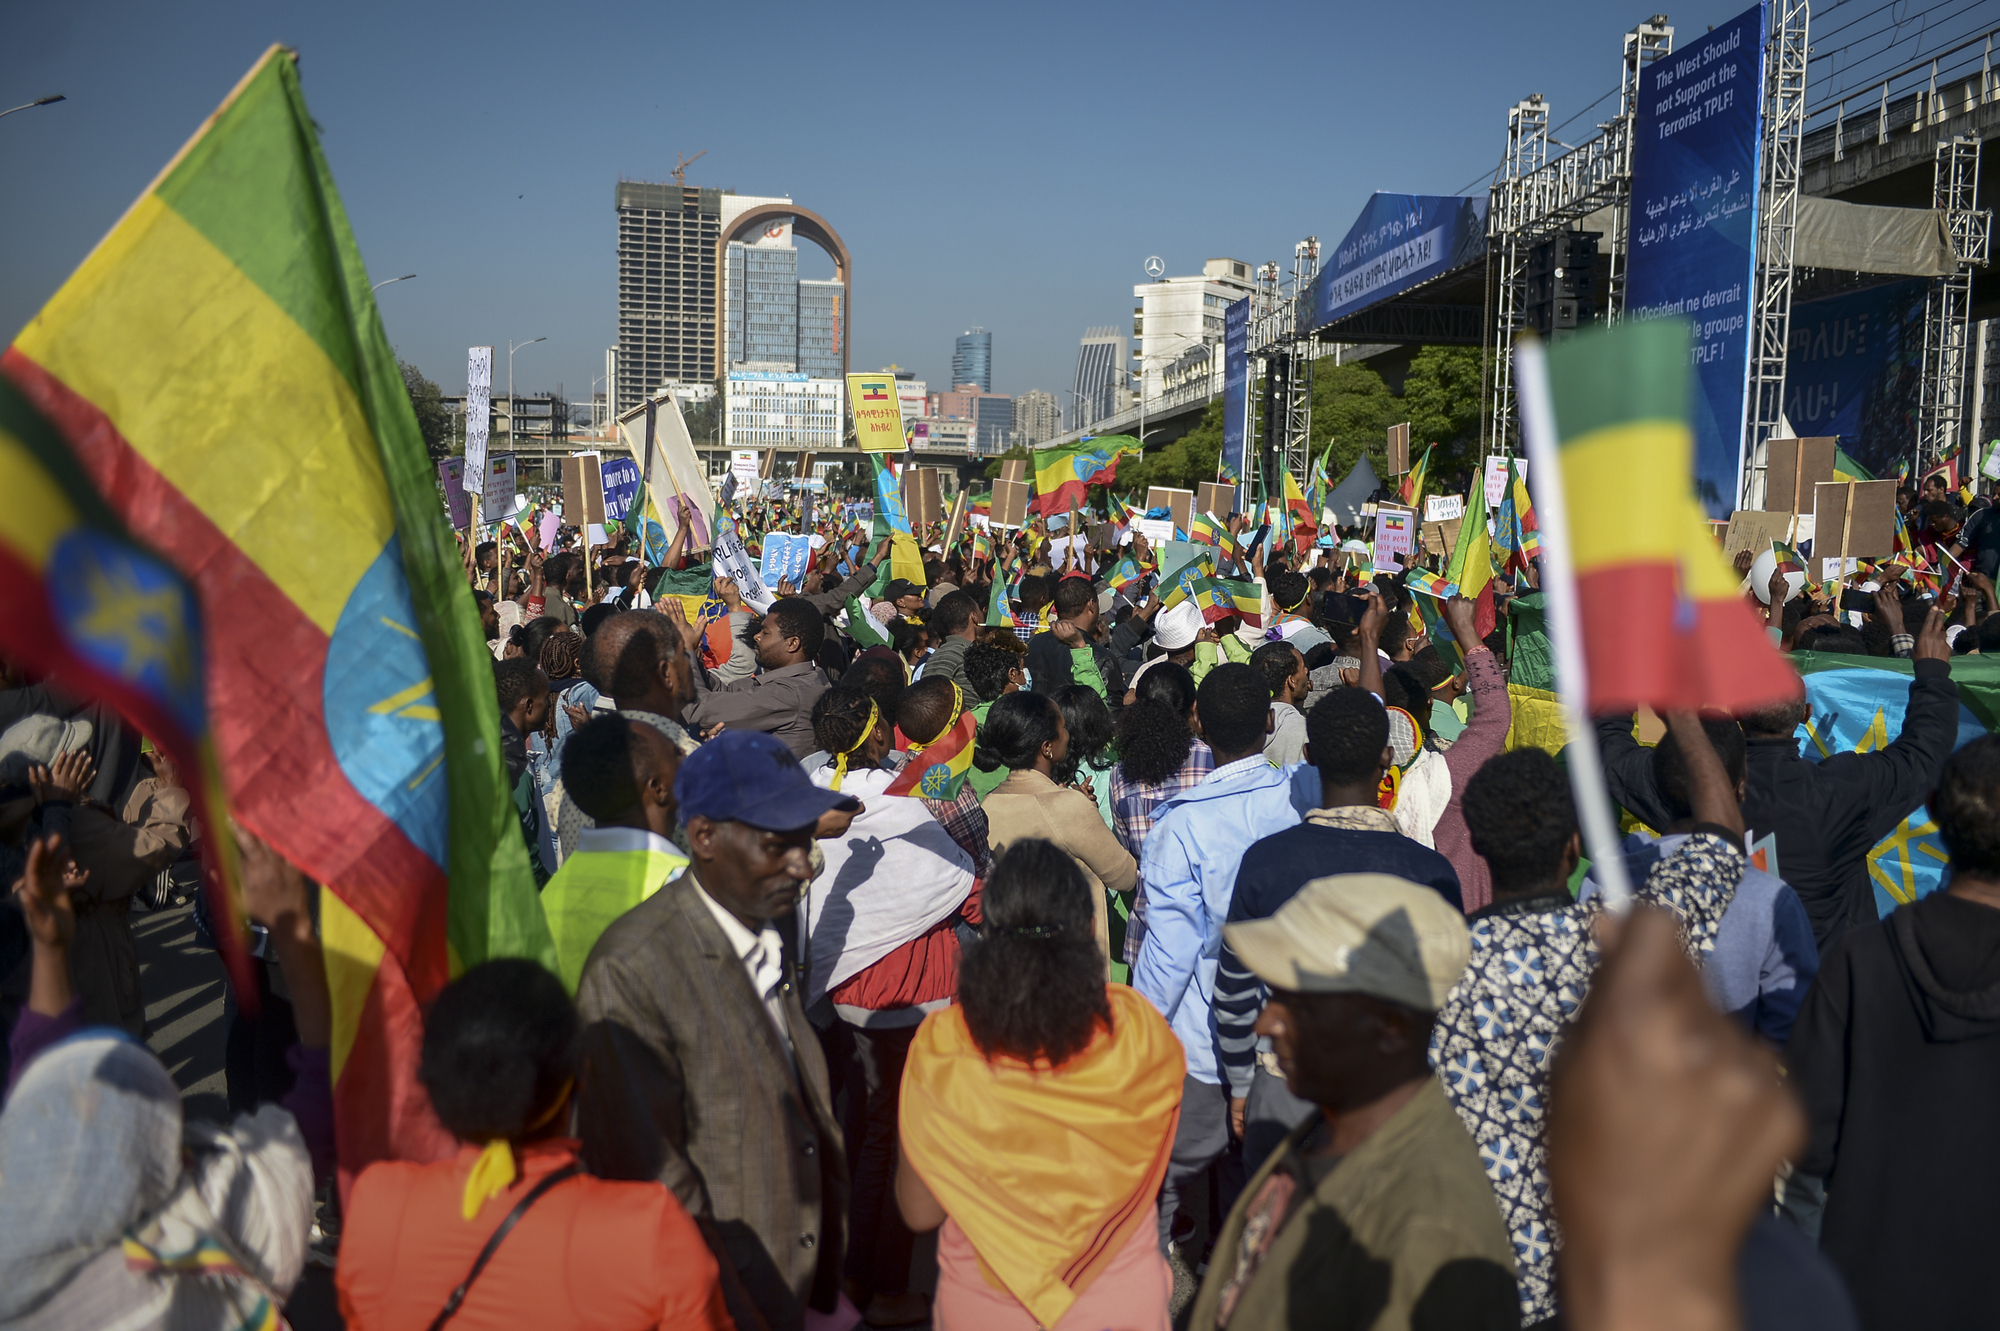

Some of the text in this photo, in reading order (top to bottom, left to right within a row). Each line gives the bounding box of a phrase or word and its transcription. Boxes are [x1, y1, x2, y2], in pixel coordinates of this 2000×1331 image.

[1656, 28, 1740, 90] The West Should
[1656, 63, 1737, 116] not Support the
[1659, 89, 1733, 139] Terrorist TPLF!
[1700, 175, 1722, 199] الغرب
[1632, 283, 1741, 324] L'Occident ne devrait
[1692, 320, 1702, 338] le
[1704, 314, 1744, 340] groupe
[1690, 343, 1718, 365] TPLF
[622, 466, 630, 483] to
[630, 467, 636, 481] a
